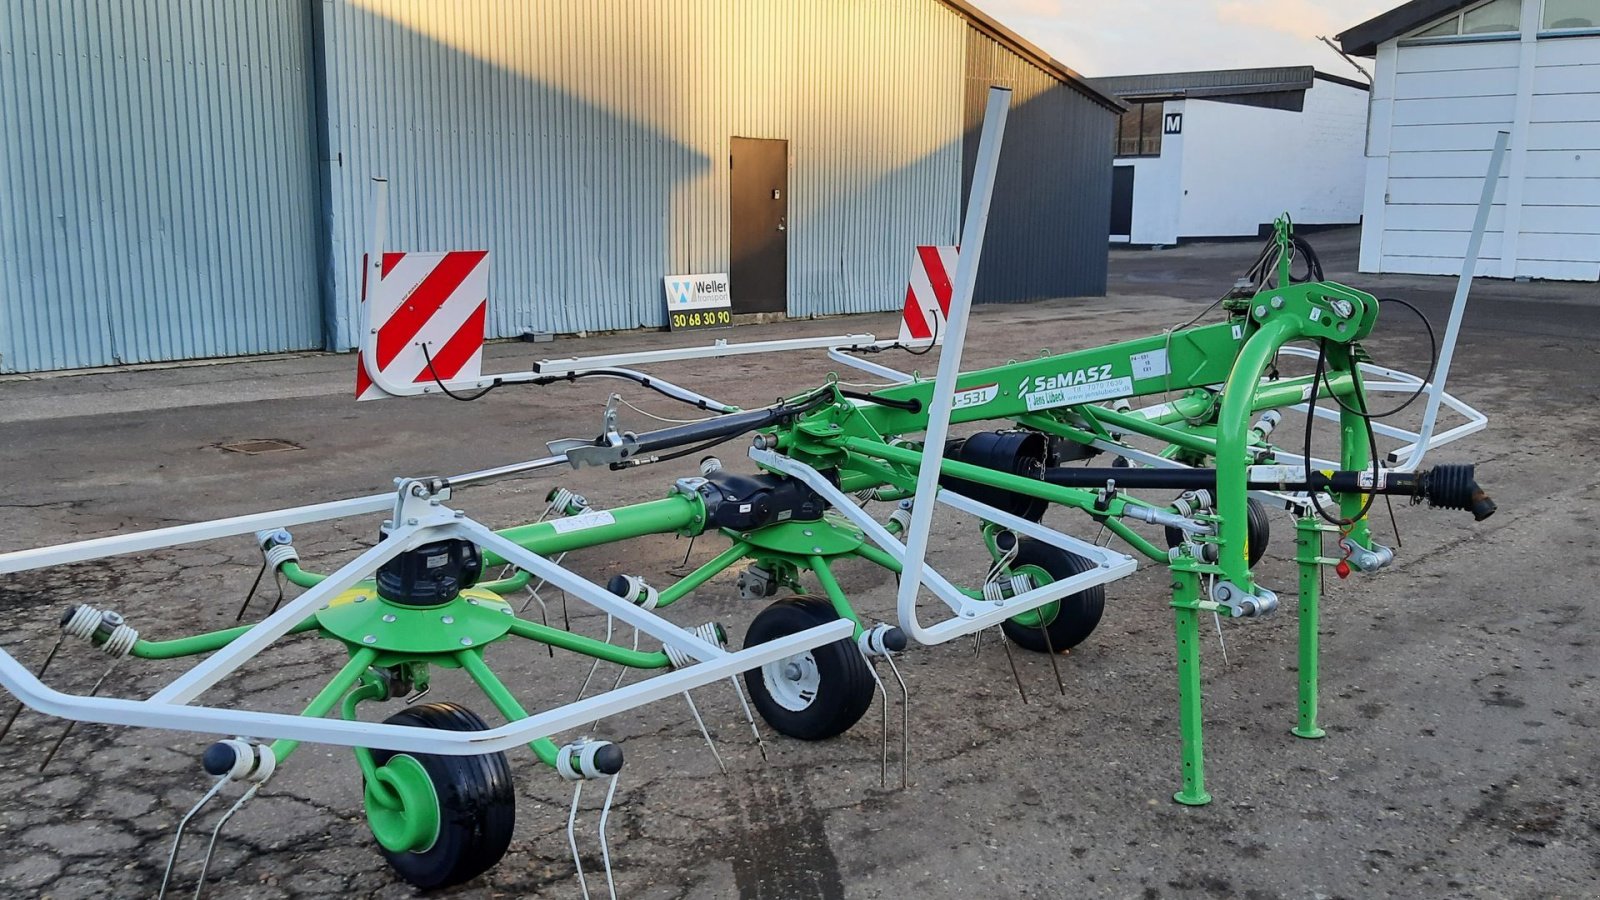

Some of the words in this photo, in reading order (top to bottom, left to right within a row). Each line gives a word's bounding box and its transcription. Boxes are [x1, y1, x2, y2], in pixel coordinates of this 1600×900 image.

[1166, 115, 1180, 132] M
[695, 280, 727, 294] Weller
[697, 293, 729, 304] transport
[673, 314, 686, 327] 30
[689, 313, 701, 326] 68
[703, 312, 716, 325] 30
[718, 311, 730, 324] 90
[1034, 364, 1112, 392] SaMASZ
